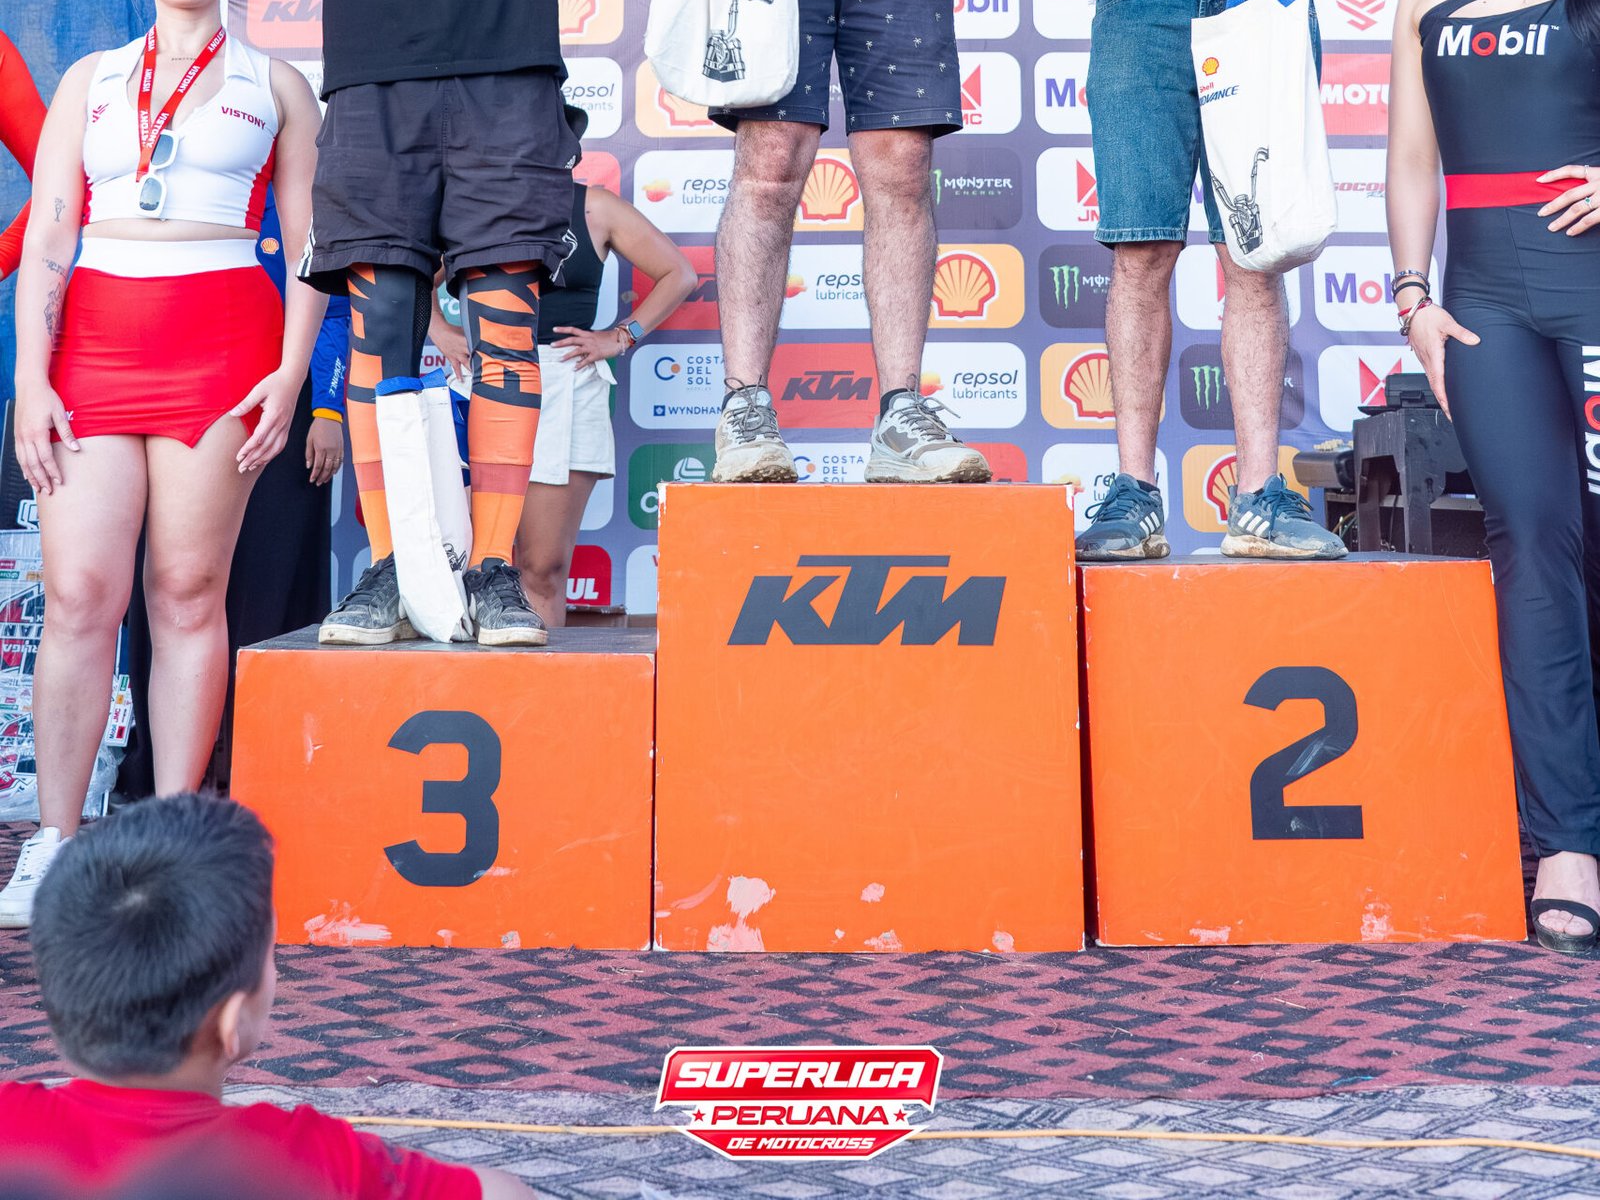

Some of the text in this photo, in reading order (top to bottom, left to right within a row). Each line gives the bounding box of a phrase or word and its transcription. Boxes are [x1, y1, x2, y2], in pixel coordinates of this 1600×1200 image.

[1437, 24, 1549, 57] Mobil
[177, 65, 200, 94] VISTONY
[562, 83, 615, 101] epsol
[1200, 85, 1240, 107] DVANCE
[221, 106, 266, 130] VISTONY
[683, 179, 730, 194] reps
[944, 176, 1013, 190] MONSTER
[682, 193, 726, 205] lubrica
[816, 274, 863, 290] reps
[687, 367, 712, 375] DEL
[952, 369, 1018, 388] repsol
[687, 378, 712, 386] SOL
[781, 370, 873, 401] KTM
[952, 388, 1018, 400] lubricants
[822, 455, 864, 464] COSTA
[822, 467, 847, 475] DEL
[727, 554, 1006, 646] KTM
[1243, 666, 1364, 841] 2
[384, 710, 501, 887] 3
